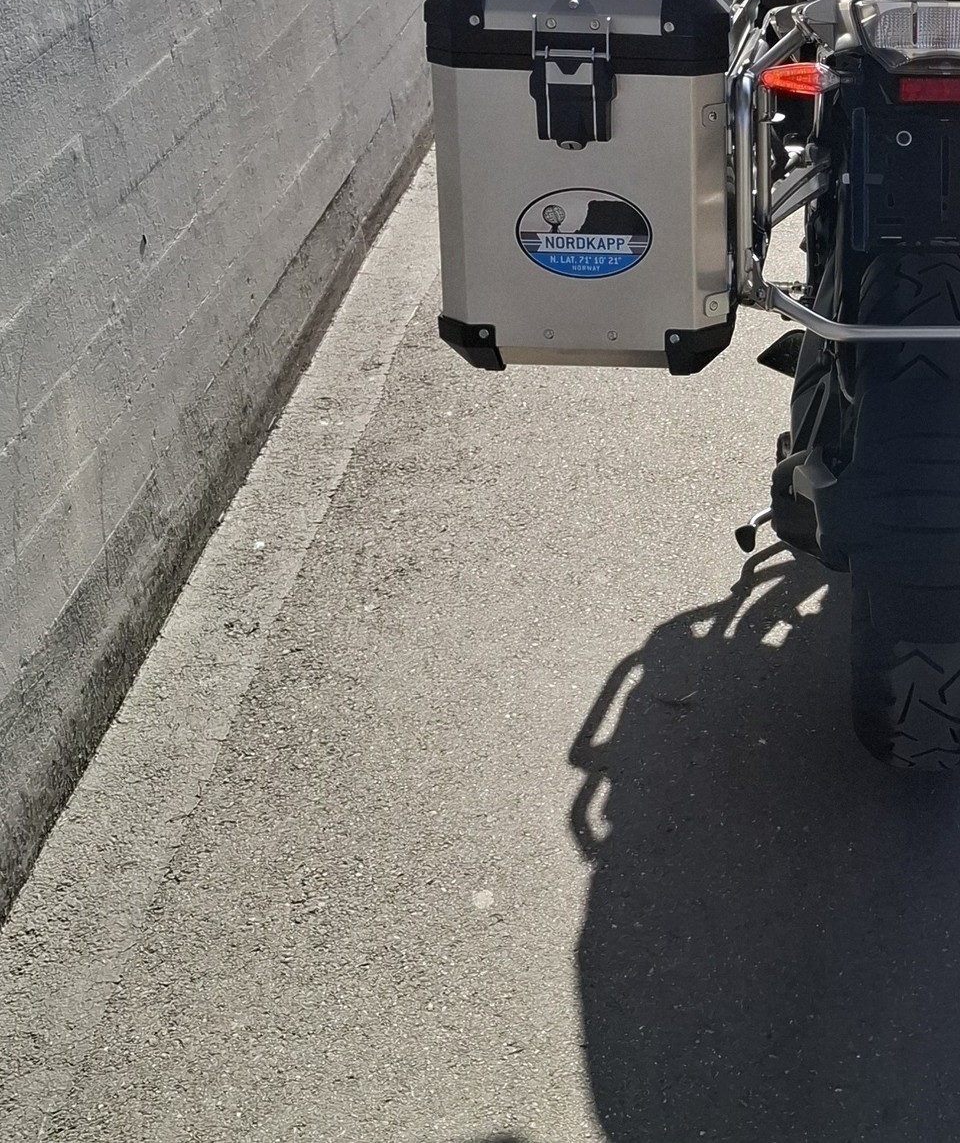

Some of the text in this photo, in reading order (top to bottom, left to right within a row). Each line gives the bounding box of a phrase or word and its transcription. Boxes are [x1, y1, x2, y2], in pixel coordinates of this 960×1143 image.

[545, 236, 625, 251] NORDKAPP
[550, 256, 559, 264] N.
[560, 256, 577, 264] LAT.
